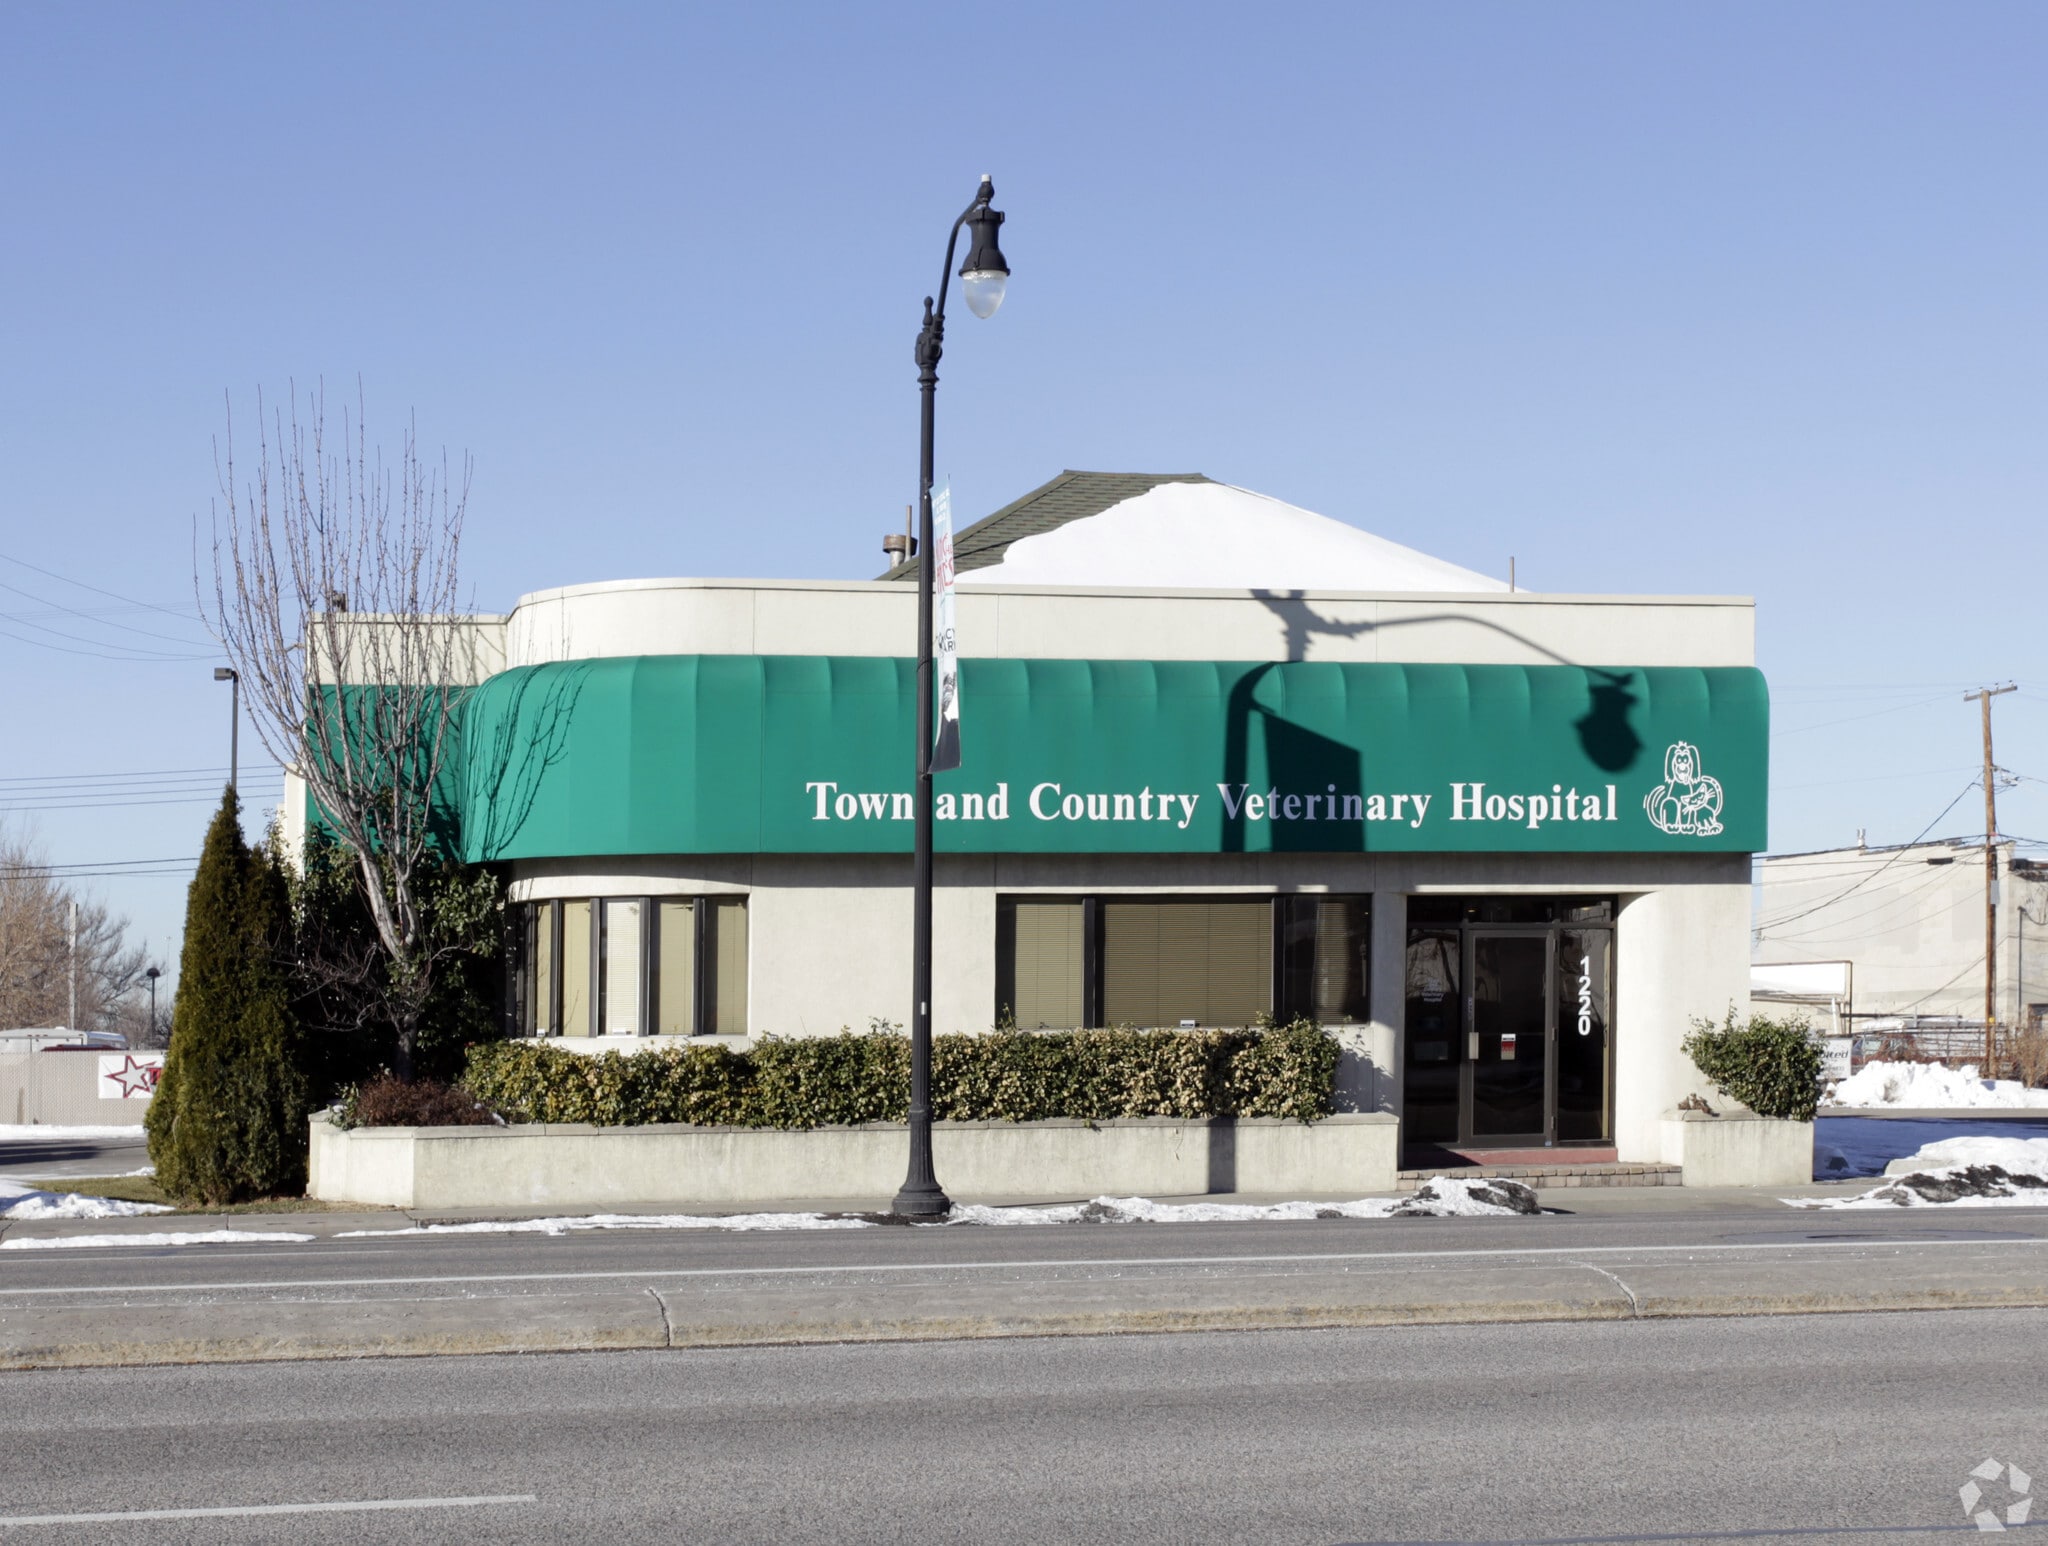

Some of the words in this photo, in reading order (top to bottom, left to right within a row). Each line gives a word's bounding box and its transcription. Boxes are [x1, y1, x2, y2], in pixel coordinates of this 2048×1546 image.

[805, 781, 916, 821] Town
[935, 782, 1010, 821] and
[1028, 782, 1201, 830] Country
[1216, 782, 1433, 829] Veterinary
[1448, 782, 1619, 829] Hospital
[1578, 955, 1592, 1036] 1220
